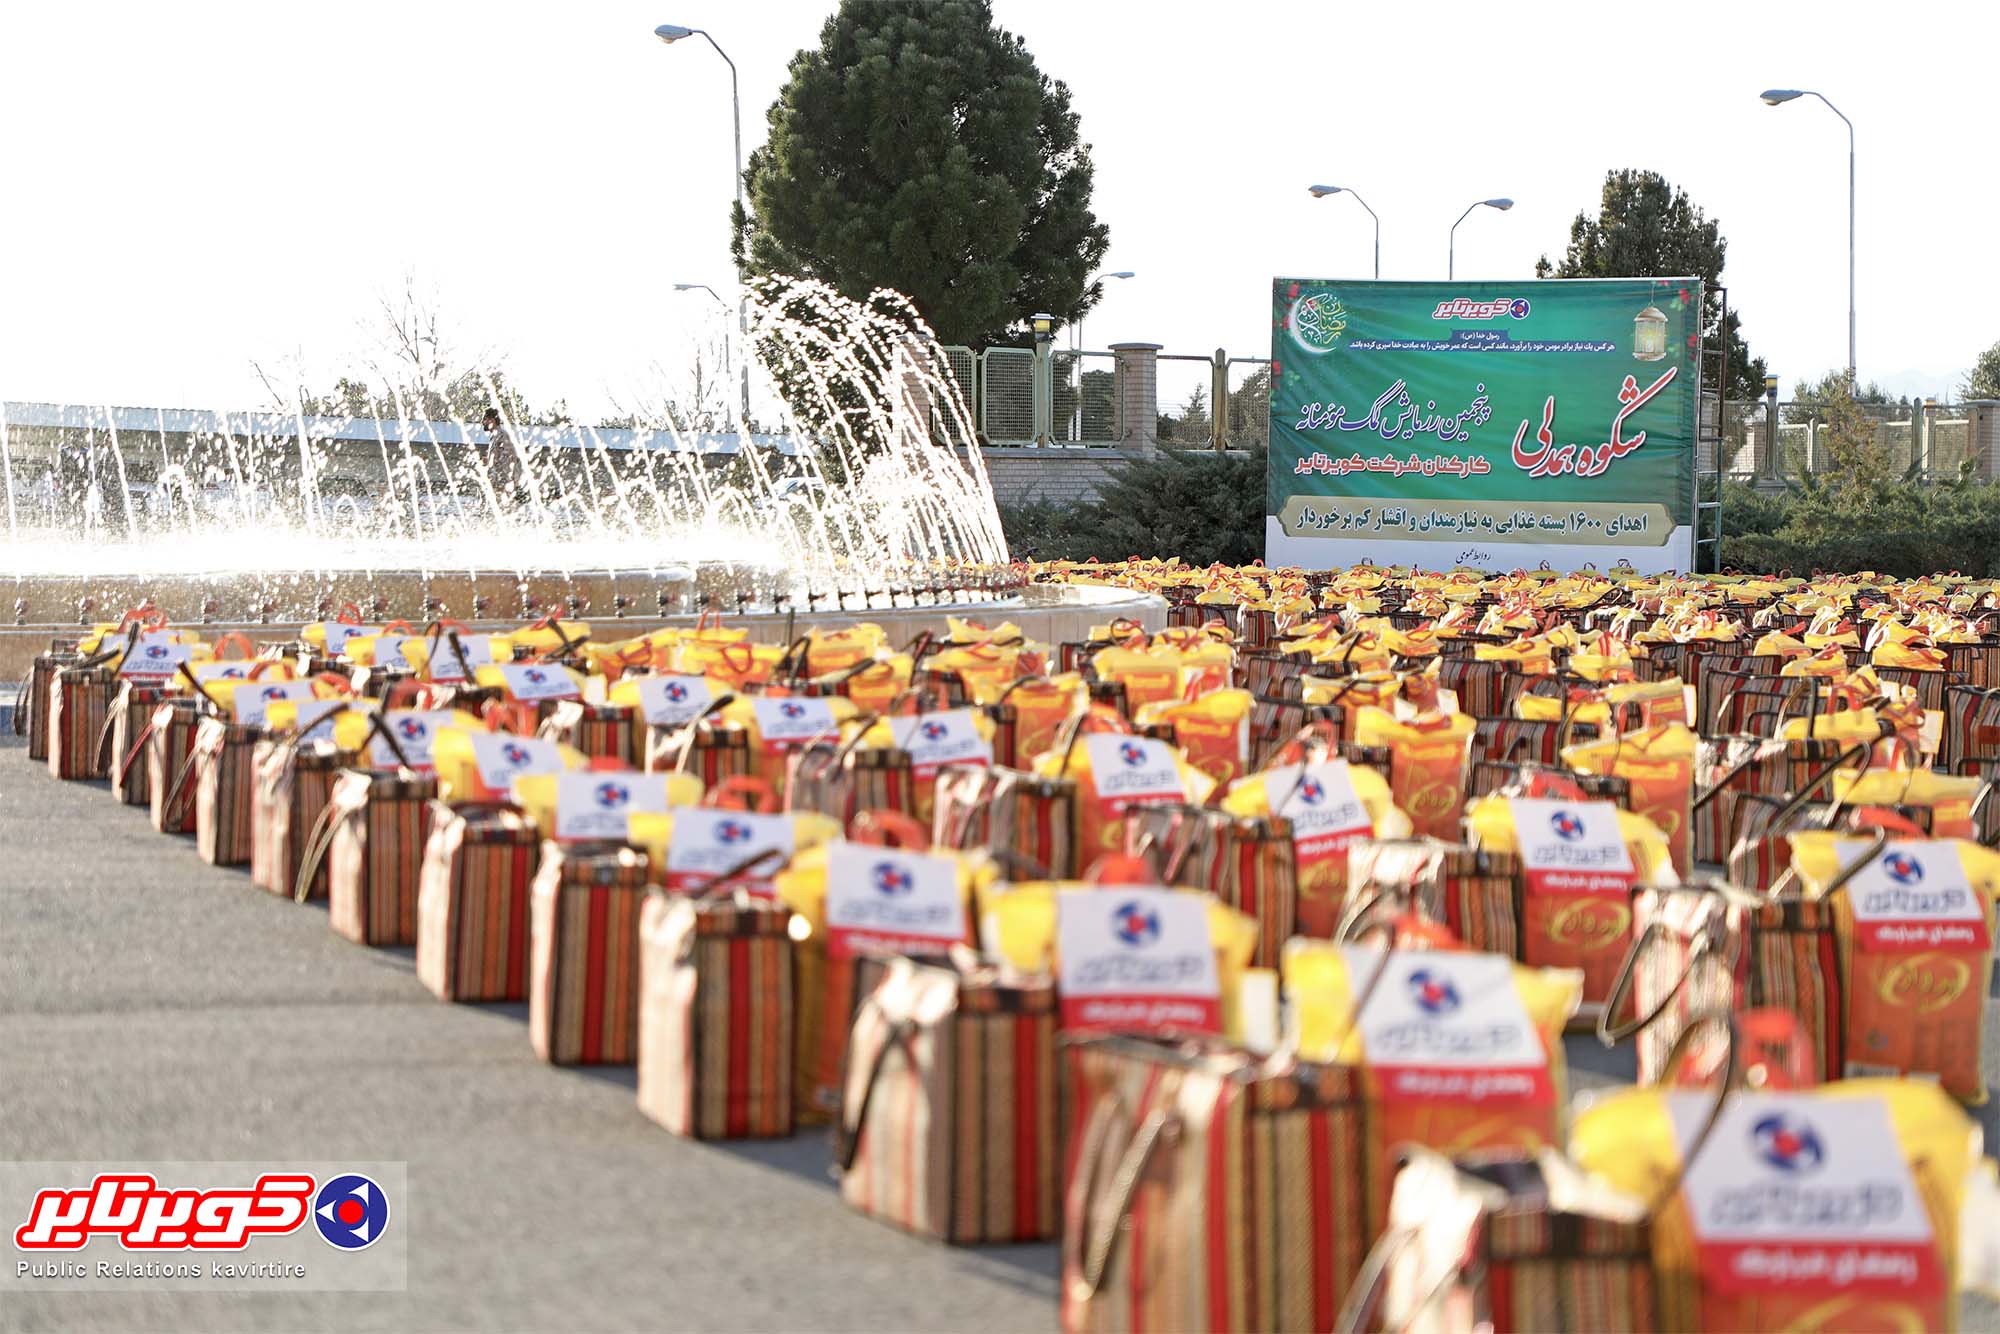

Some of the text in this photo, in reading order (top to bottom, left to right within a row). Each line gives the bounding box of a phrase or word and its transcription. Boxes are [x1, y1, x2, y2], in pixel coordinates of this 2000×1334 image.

[1432, 298, 1511, 320] کویرتایر
[1475, 332, 1486, 340] خدا
[1486, 332, 1500, 341] رسول
[1364, 341, 1376, 350] کرده
[1376, 342, 1392, 350] سپری
[1392, 341, 1402, 349] خدا
[1402, 341, 1418, 350] عبادت
[1432, 341, 1450, 351] خویش
[1450, 342, 1460, 351] عمر
[1482, 342, 1495, 351] کسی
[1496, 342, 1508, 350] مانند
[1528, 342, 1533, 351] را
[1533, 342, 1544, 351] خود
[1545, 343, 1560, 351] مومن
[1560, 342, 1574, 351] برادر
[1574, 342, 1583, 351] نیاز
[1594, 342, 1606, 351] کس
[1606, 342, 1615, 351] هر
[1339, 378, 1407, 430] کمک
[1379, 391, 1440, 439] رزمایش
[1438, 383, 1491, 441] پنجمین
[1512, 366, 1678, 478] شکوه همدلی
[1295, 452, 1491, 478] کارکنان شرکت کویرتایر
[1354, 507, 1372, 530] کم
[1374, 507, 1407, 531] اقشار
[1419, 510, 1477, 534] نیازمندان
[1481, 514, 1493, 533] به
[1495, 511, 1535, 534] غذایی
[1569, 511, 1601, 532] ۱۶۰۰
[1408, 516, 1416, 532] و
[1538, 514, 1566, 534] بسته
[1605, 513, 1648, 536] اهدای
[1455, 549, 1491, 564] روابط عمومی
